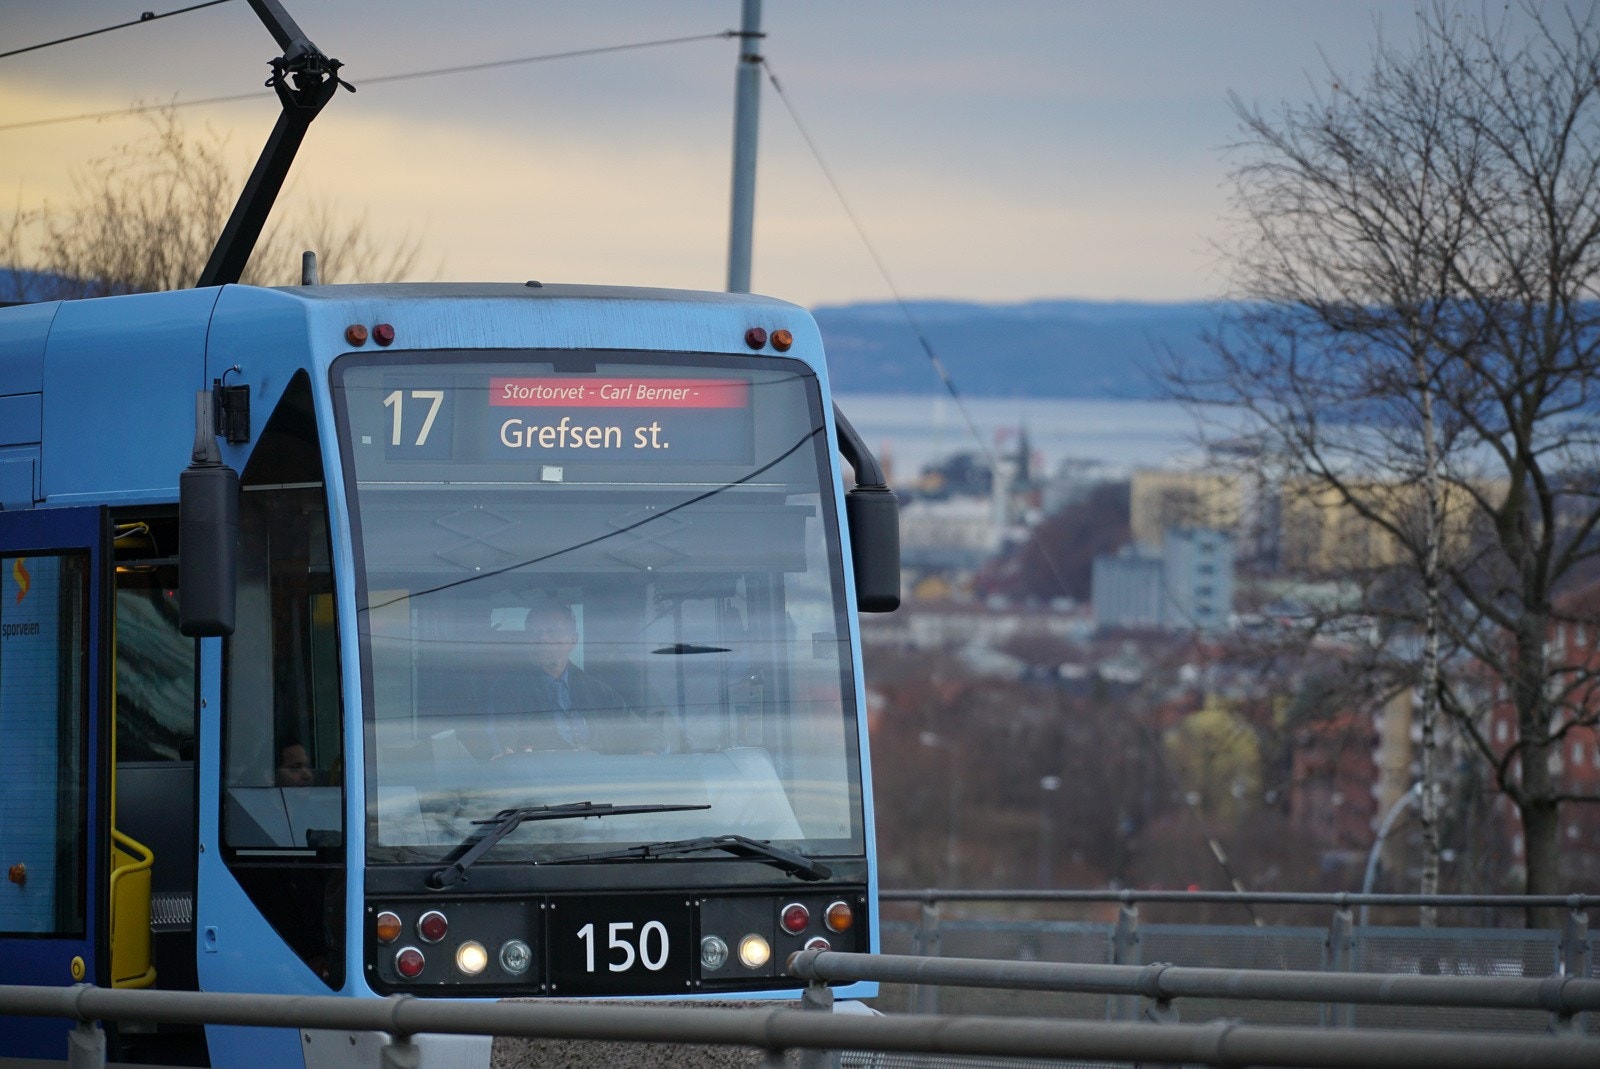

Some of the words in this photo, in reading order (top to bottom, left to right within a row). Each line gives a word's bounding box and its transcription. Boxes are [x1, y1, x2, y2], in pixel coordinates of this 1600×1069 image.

[502, 383, 585, 400] Stortorvet
[600, 384, 632, 400] Carl
[635, 384, 690, 400] Berner
[383, 390, 444, 446] 17
[500, 416, 622, 449] Grefsen
[633, 421, 669, 449] st.
[1, 618, 40, 640] sporveien
[576, 920, 669, 972] 150
